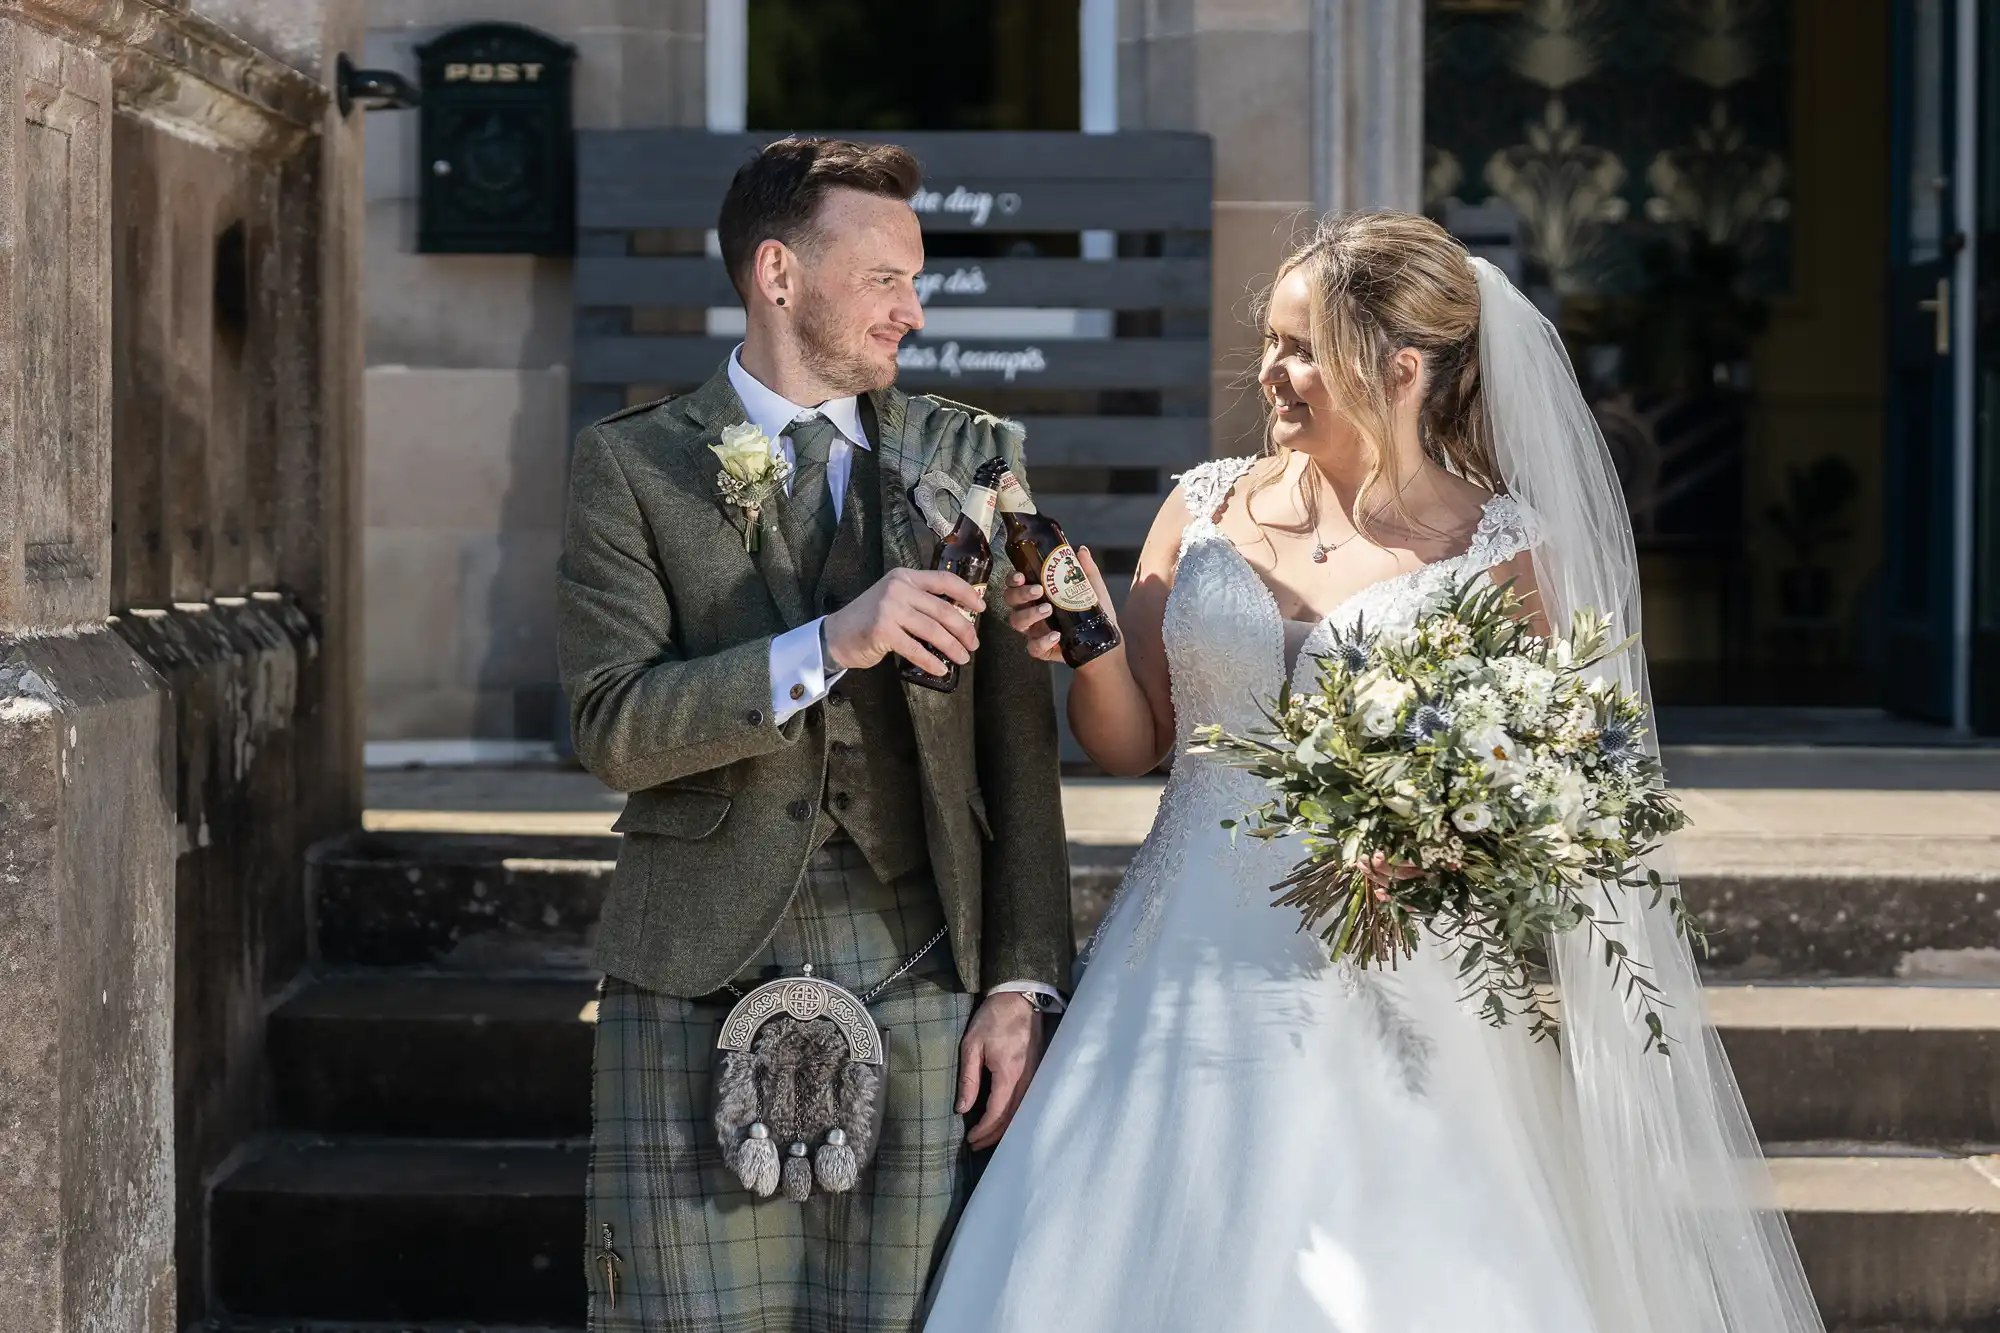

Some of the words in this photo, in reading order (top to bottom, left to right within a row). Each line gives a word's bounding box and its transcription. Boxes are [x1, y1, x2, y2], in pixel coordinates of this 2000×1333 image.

[444, 62, 545, 82] POST
[943, 185, 993, 227] day
[1046, 556, 1061, 595] BIRRA
